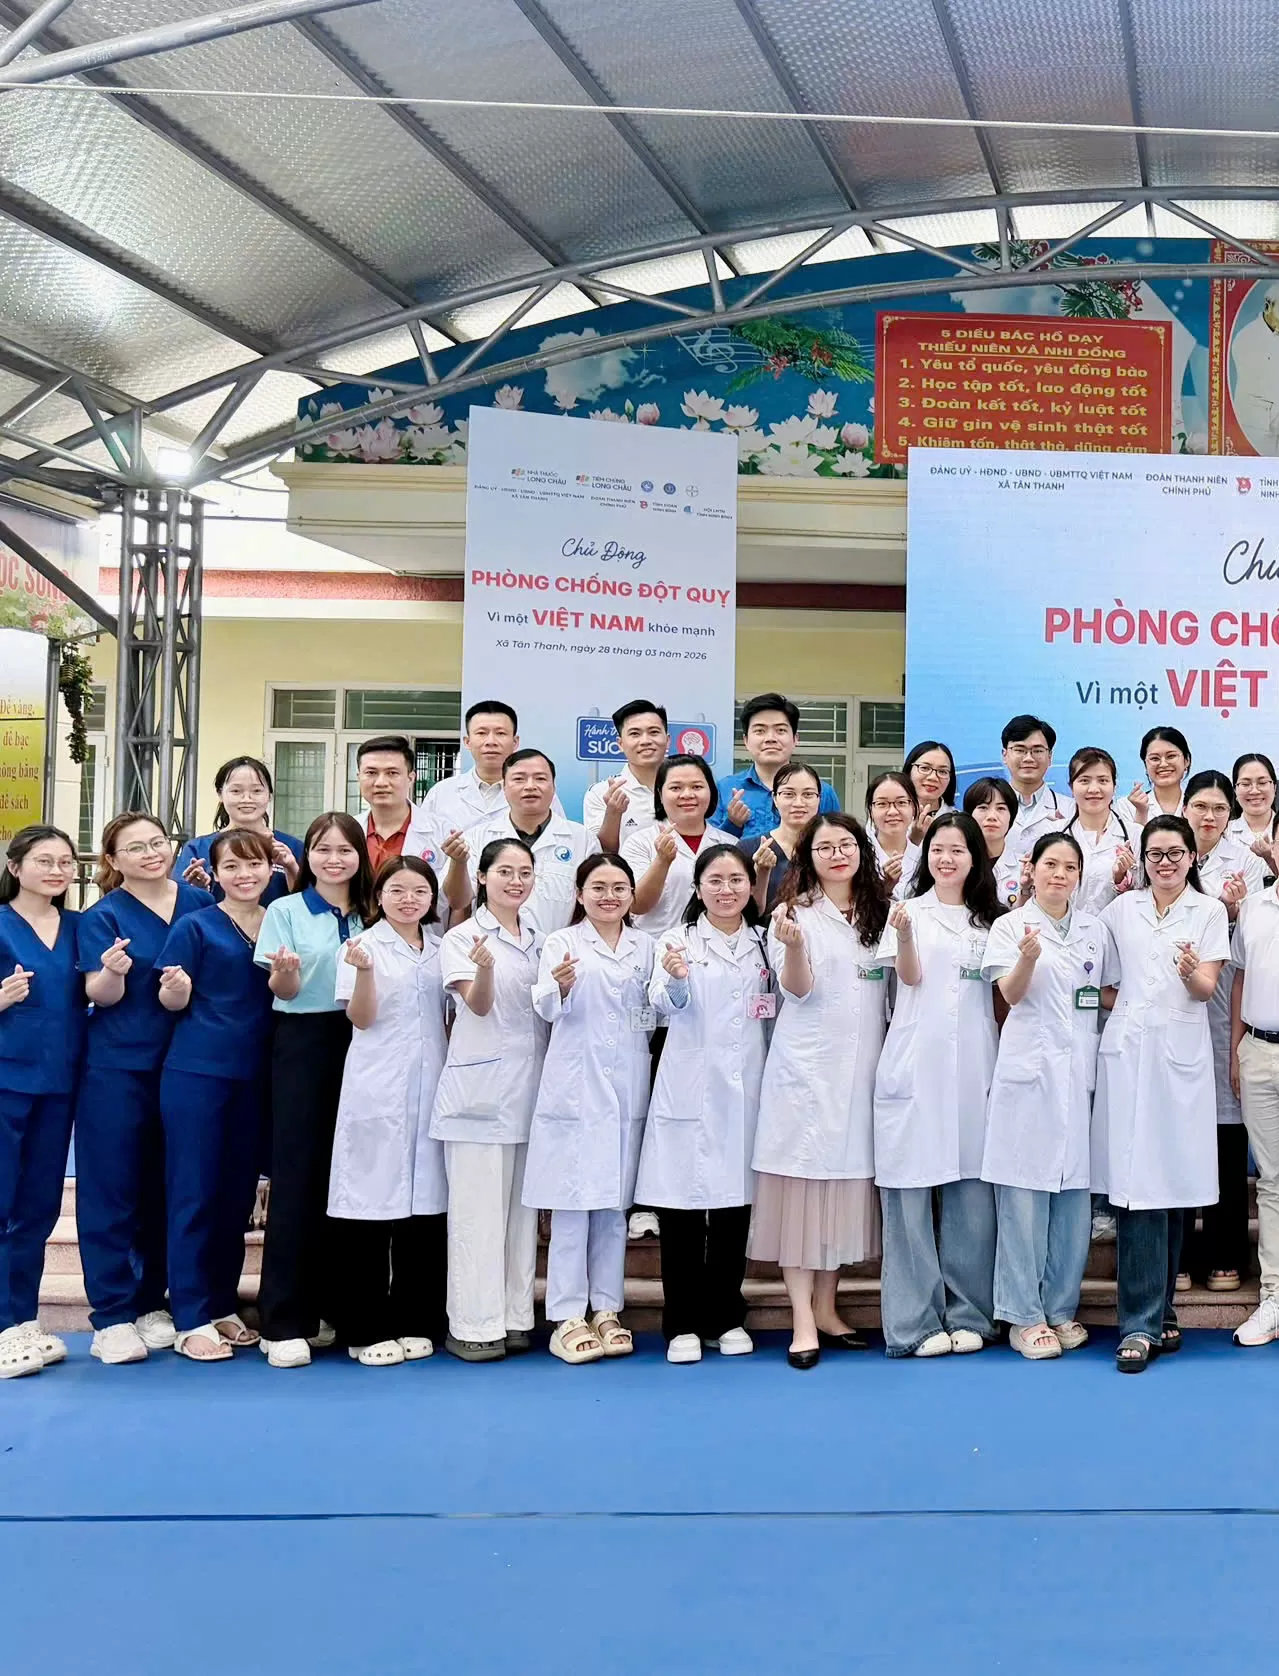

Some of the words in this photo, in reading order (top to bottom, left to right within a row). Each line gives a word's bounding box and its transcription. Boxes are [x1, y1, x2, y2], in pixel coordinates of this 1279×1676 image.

[941, 329, 951, 338] 5
[1000, 330, 1034, 340] BÁC
[1068, 334, 1104, 345] DẠY
[917, 340, 966, 352] THIẾU
[971, 342, 1011, 353] NIÊN
[1016, 344, 1039, 355] VÀ
[1044, 347, 1073, 357] NHI
[900, 358, 914, 369] 1.
[920, 358, 953, 370] Yêu
[958, 357, 977, 371] tổ
[981, 359, 1028, 374] quốc,
[1033, 363, 1063, 375] yêu
[1069, 363, 1111, 378] đồng
[1116, 365, 1148, 377] bào
[898, 377, 915, 388] 2.
[921, 377, 957, 392] Học
[962, 379, 993, 393] tập
[998, 378, 1030, 393] tốt,
[1036, 382, 1064, 393] lao
[1070, 383, 1115, 398] động
[1120, 384, 1147, 397] tốt
[898, 397, 915, 408] 3.
[921, 397, 971, 409] Đoàn
[977, 398, 1006, 411] kết
[1012, 398, 1044, 413] tốt,
[1051, 401, 1072, 415] kỷ
[1079, 403, 1115, 417] luật
[1120, 403, 1147, 416] tốt
[930, 466, 957, 476] ĐẢNG
[979, 468, 1007, 477] HĐND
[1015, 469, 1042, 478] UBND
[1049, 470, 1088, 480] UBMTTQ
[1089, 470, 1110, 481] VIỆT
[1111, 472, 1133, 480] NAM
[1145, 473, 1172, 483] ĐOÀN
[1175, 475, 1205, 484] THANH
[1207, 475, 1228, 485] NIÊN
[998, 480, 1011, 489] XÃ
[1012, 480, 1031, 490] TÂN
[1033, 482, 1065, 491] THANH
[1162, 486, 1190, 496] CHÍNH
[561, 537, 598, 557] Chủ
[600, 541, 647, 569] Động
[471, 568, 549, 590] PHÒNG
[555, 572, 633, 597] CHỐNG
[637, 580, 681, 603] ĐỘT
[686, 587, 730, 608] QUỴ
[487, 611, 500, 621] Vì
[504, 614, 528, 625] một
[532, 606, 584, 631] VIỆT
[590, 613, 644, 633] NAM
[648, 622, 679, 634] khỏe
[682, 627, 715, 637] mạnh
[1044, 598, 1199, 646] PHÒNG
[495, 639, 509, 648] Xã
[513, 640, 530, 649] Tân
[534, 641, 568, 652] Thanh,
[570, 644, 596, 655] ngày
[598, 645, 610, 654] 28
[612, 646, 642, 657] tháng
[645, 648, 657, 657] 03
[659, 650, 682, 659] năm
[684, 651, 707, 660] 2026
[1076, 681, 1100, 704] Vì
[1110, 681, 1158, 710] một
[1165, 658, 1268, 719] VIỆT
